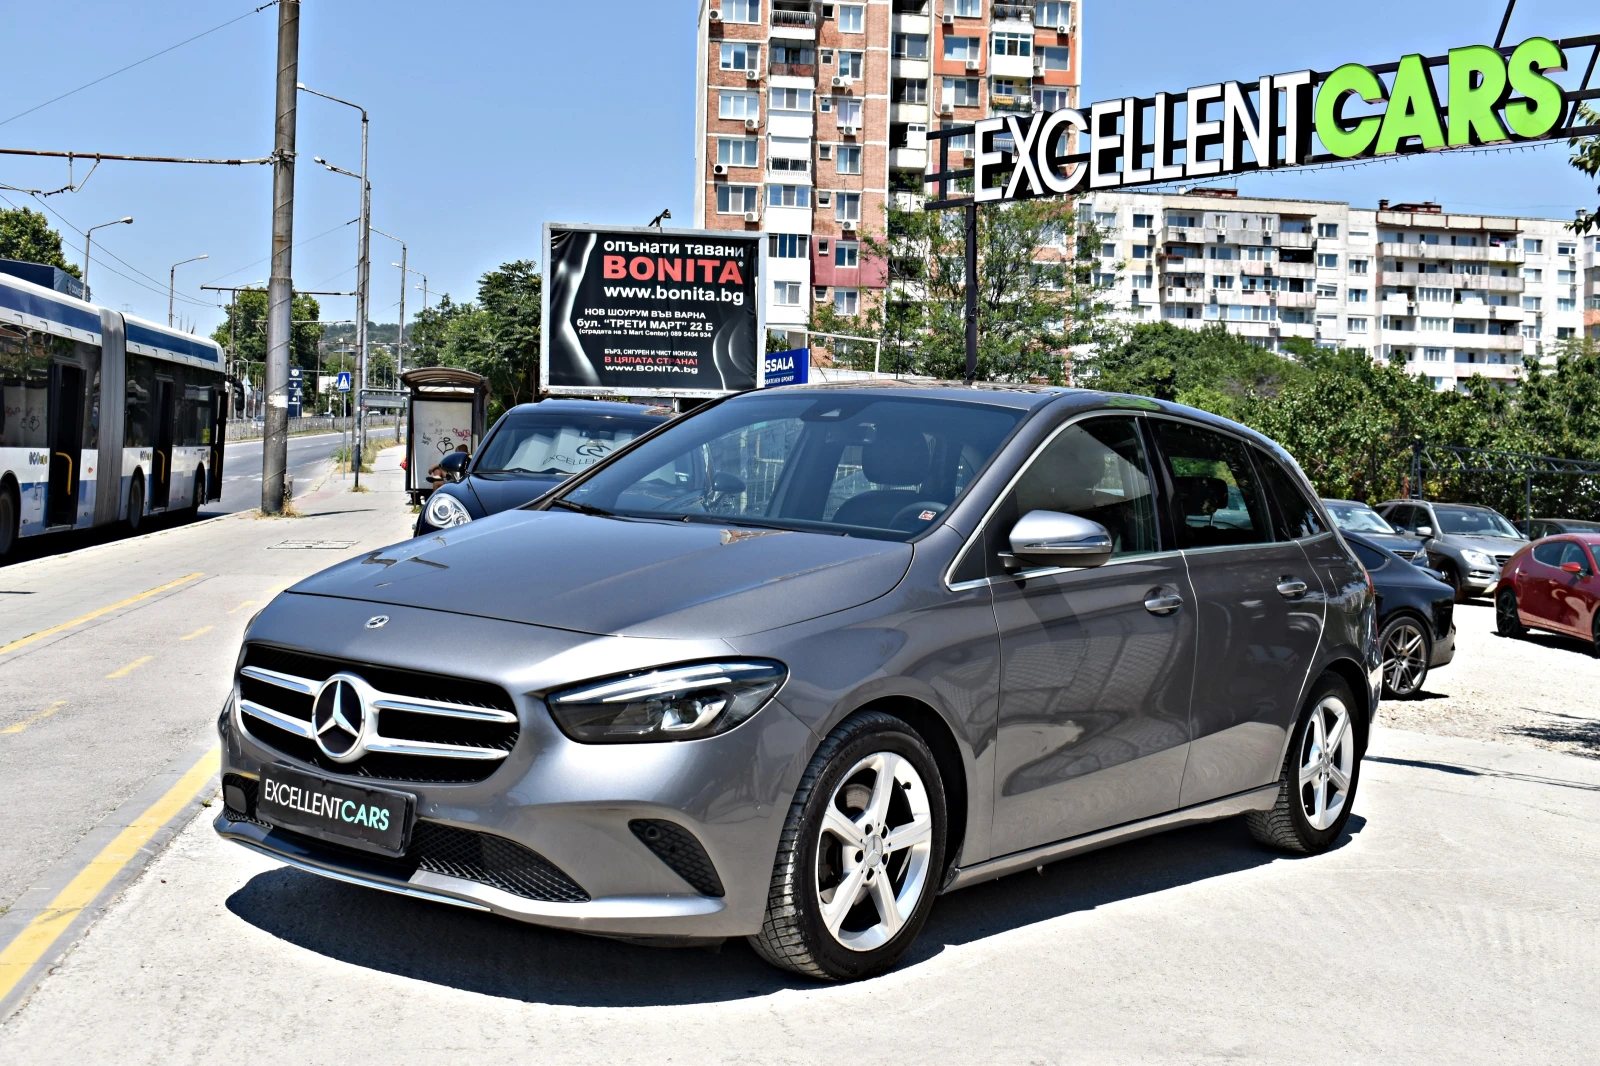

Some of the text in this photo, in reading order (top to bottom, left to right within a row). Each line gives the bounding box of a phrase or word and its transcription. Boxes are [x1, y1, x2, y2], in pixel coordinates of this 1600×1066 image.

[603, 285, 744, 306] www.bonita.bg
[584, 307, 707, 320] НОВ ШОУРУМ ВЪВ ВАРНА
[576, 318, 601, 329] бул.
[689, 322, 703, 331] 22
[705, 322, 714, 331] Б
[614, 356, 654, 364] ЦЯЛАТА
[604, 364, 699, 375] www.BONITA.bg
